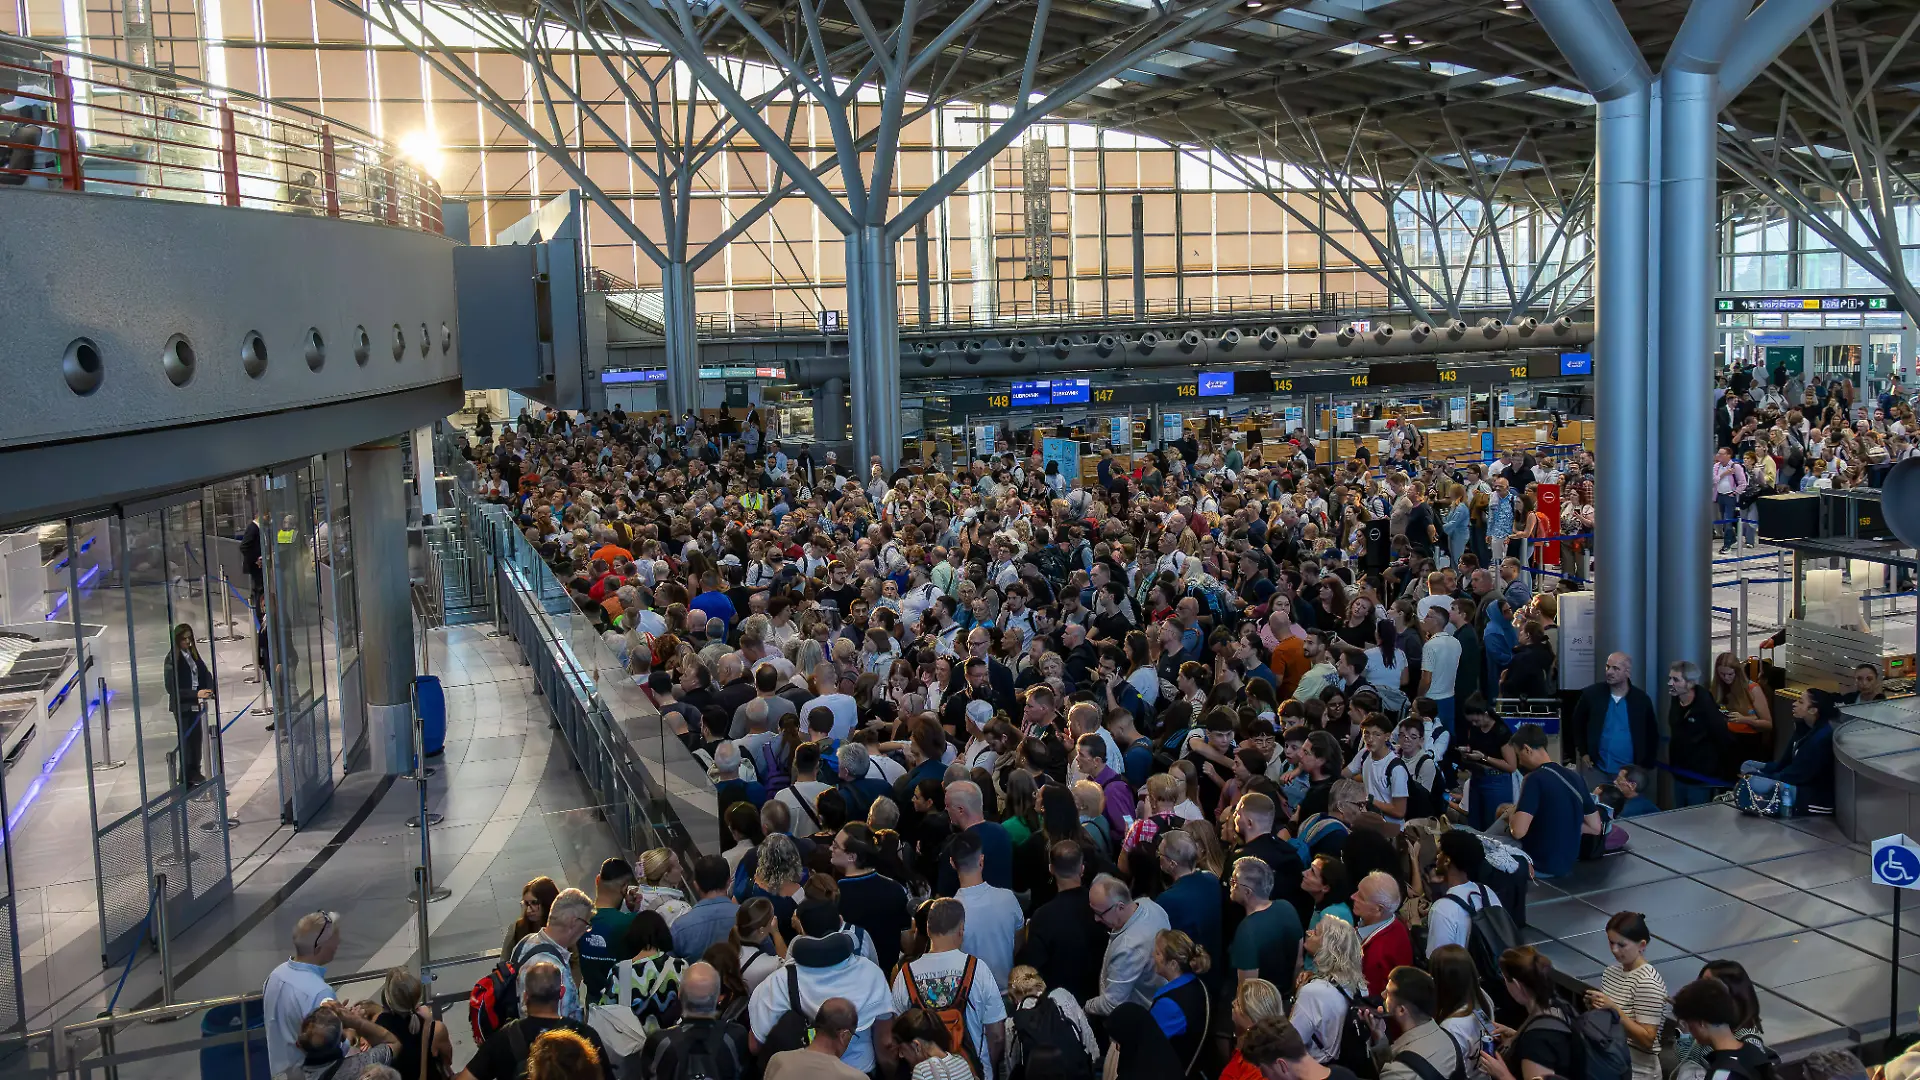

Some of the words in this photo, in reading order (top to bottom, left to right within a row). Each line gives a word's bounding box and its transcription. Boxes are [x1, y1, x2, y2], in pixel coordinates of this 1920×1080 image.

[1440, 371, 1457, 382] 143
[1510, 367, 1527, 377] 142
[1274, 380, 1293, 391] 145
[1350, 376, 1368, 387] 144
[1094, 389, 1114, 401] 147
[1177, 385, 1197, 397] 146
[988, 395, 1008, 407] 148
